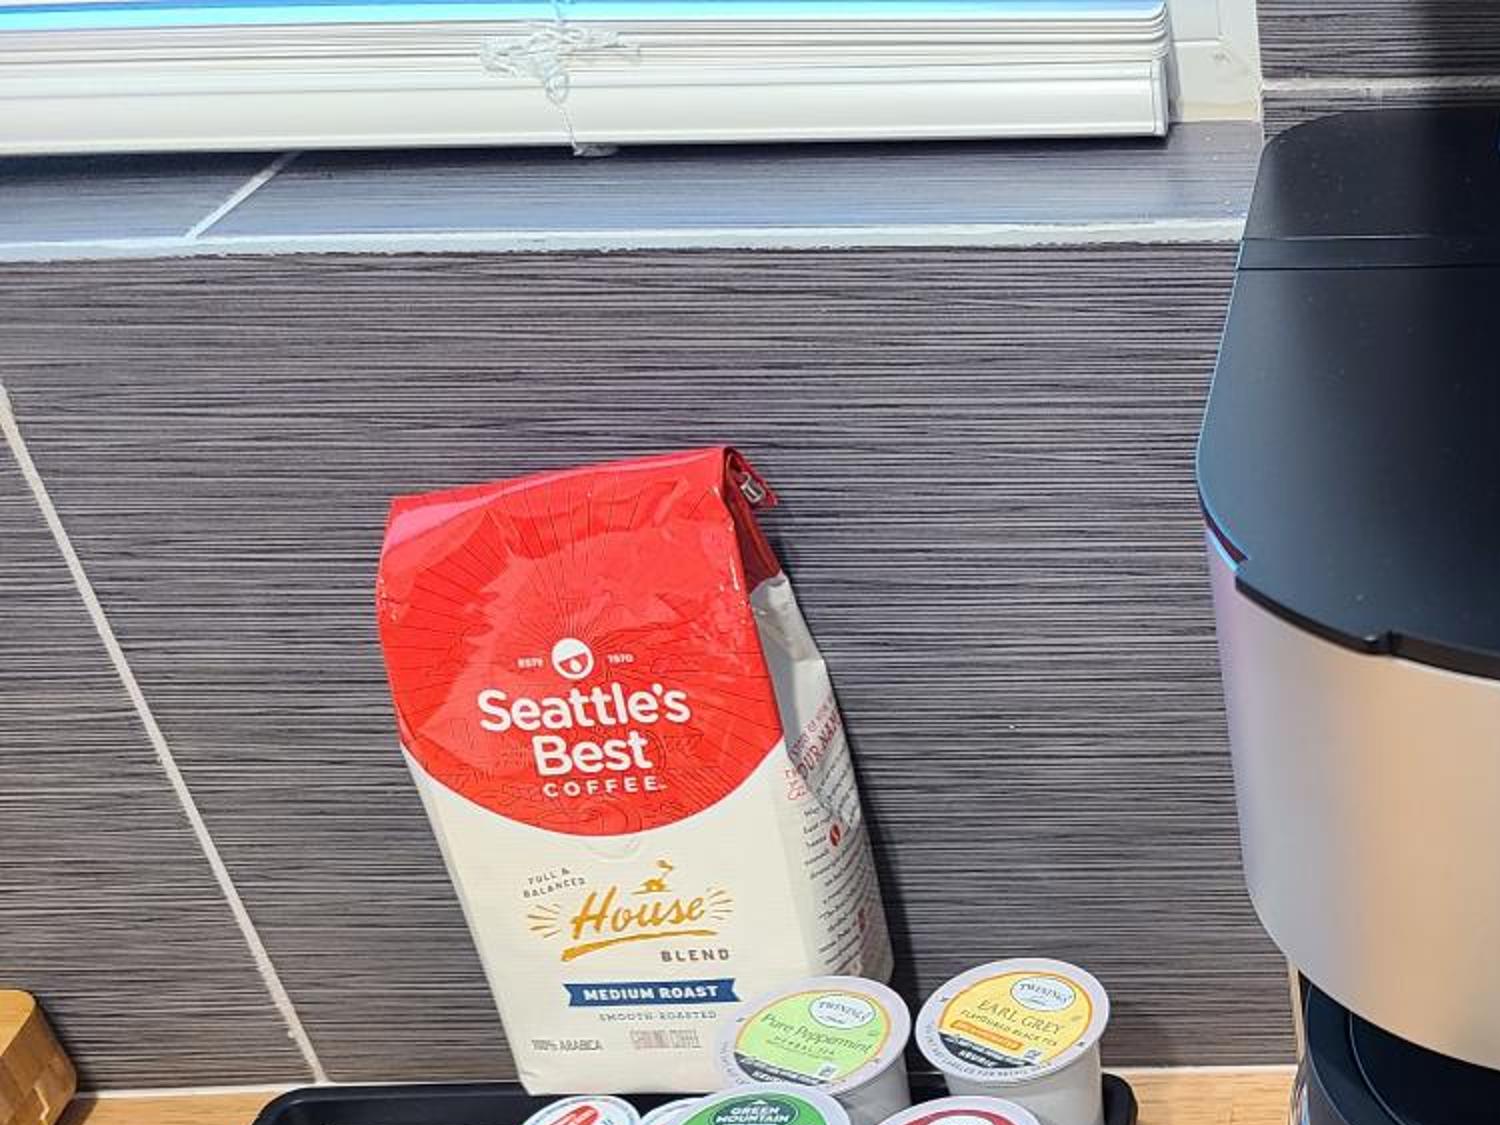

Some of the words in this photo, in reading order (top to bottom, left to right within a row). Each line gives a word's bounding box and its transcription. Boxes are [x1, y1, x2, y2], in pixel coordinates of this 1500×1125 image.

[477, 681, 692, 732] Seattle's
[531, 730, 653, 776] Best
[542, 776, 657, 798] COFFEE
[569, 885, 706, 940] House
[659, 948, 730, 963] BLEND
[583, 988, 655, 1002] MEDIUM
[659, 985, 719, 999] ROAST
[977, 999, 1018, 1023] EARL
[1021, 1015, 1061, 1035] GREY
[761, 1012, 795, 1033] Pure
[793, 1024, 874, 1056] Peppermint
[715, 1114, 791, 1124] MOUNTAIN
[730, 1106, 780, 1116] GREEN
